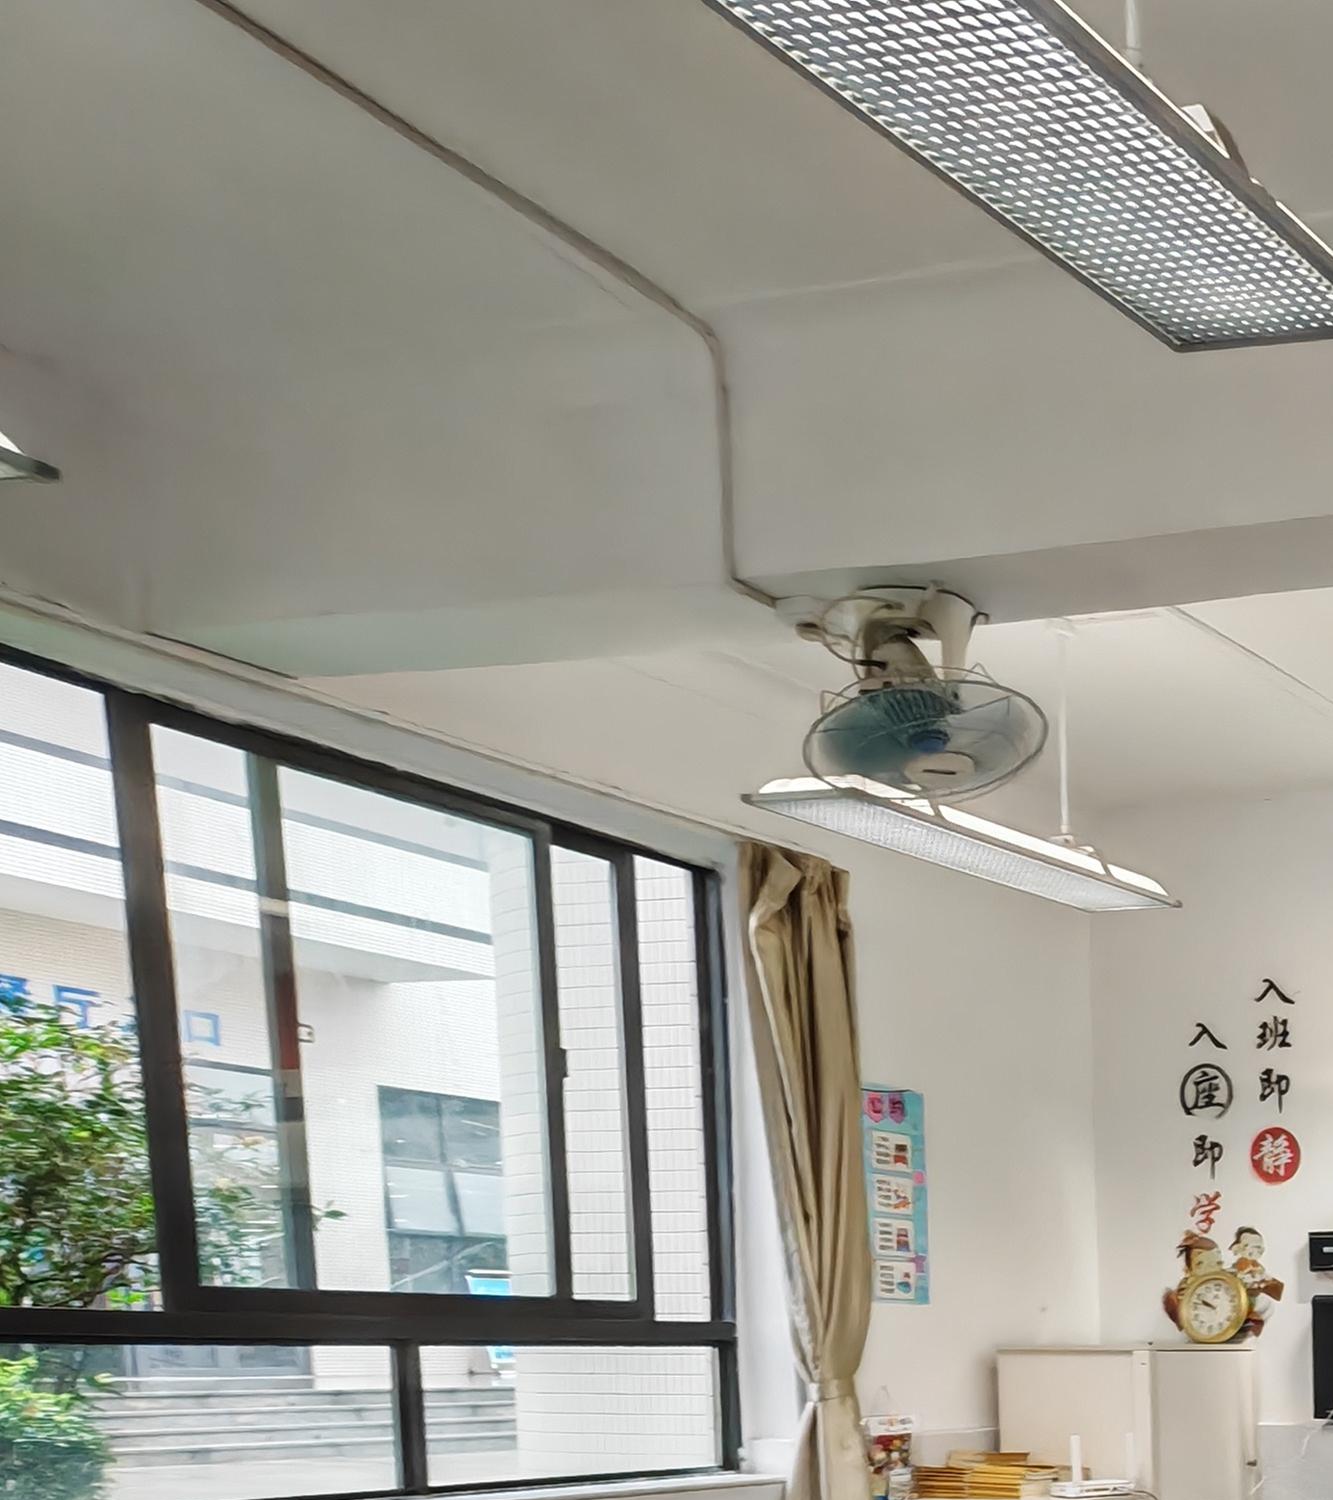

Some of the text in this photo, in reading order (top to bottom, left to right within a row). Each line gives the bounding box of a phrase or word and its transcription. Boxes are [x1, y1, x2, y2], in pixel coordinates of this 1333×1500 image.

[1188, 1022, 1229, 1234] 入座即学
[1253, 978, 1296, 1178] 入班即静
